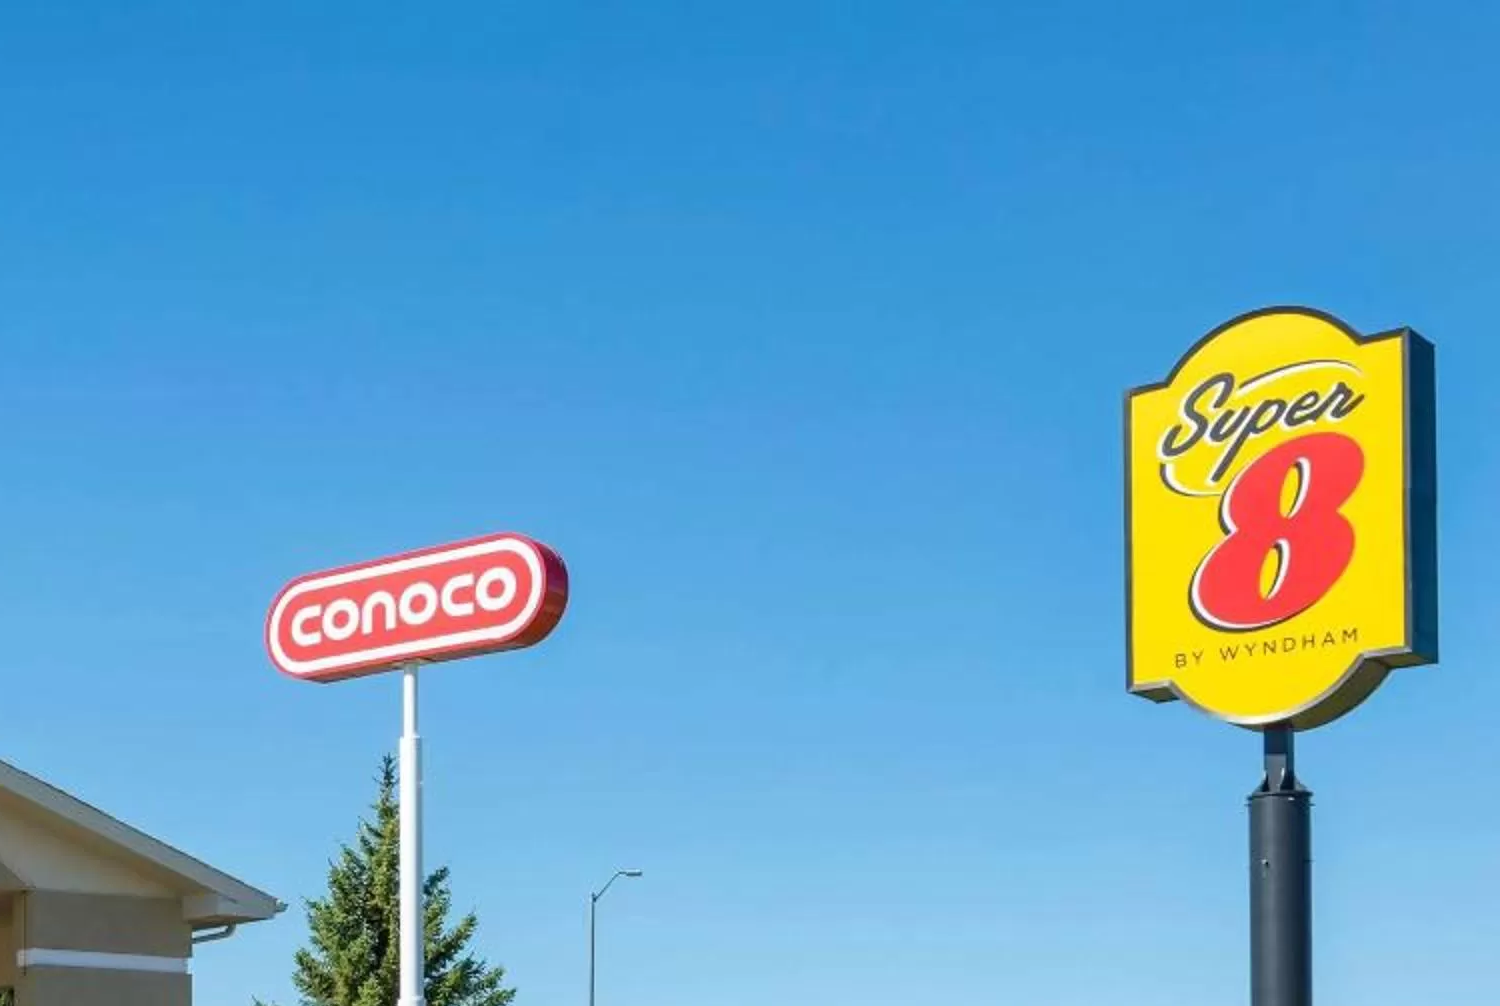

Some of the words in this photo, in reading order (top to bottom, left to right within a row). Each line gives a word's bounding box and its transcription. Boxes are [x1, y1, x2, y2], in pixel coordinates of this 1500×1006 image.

[1158, 371, 1365, 484] Super
[1187, 431, 1365, 633] 8
[1174, 650, 1205, 669] BY
[1218, 627, 1359, 662] WYNDHAM
